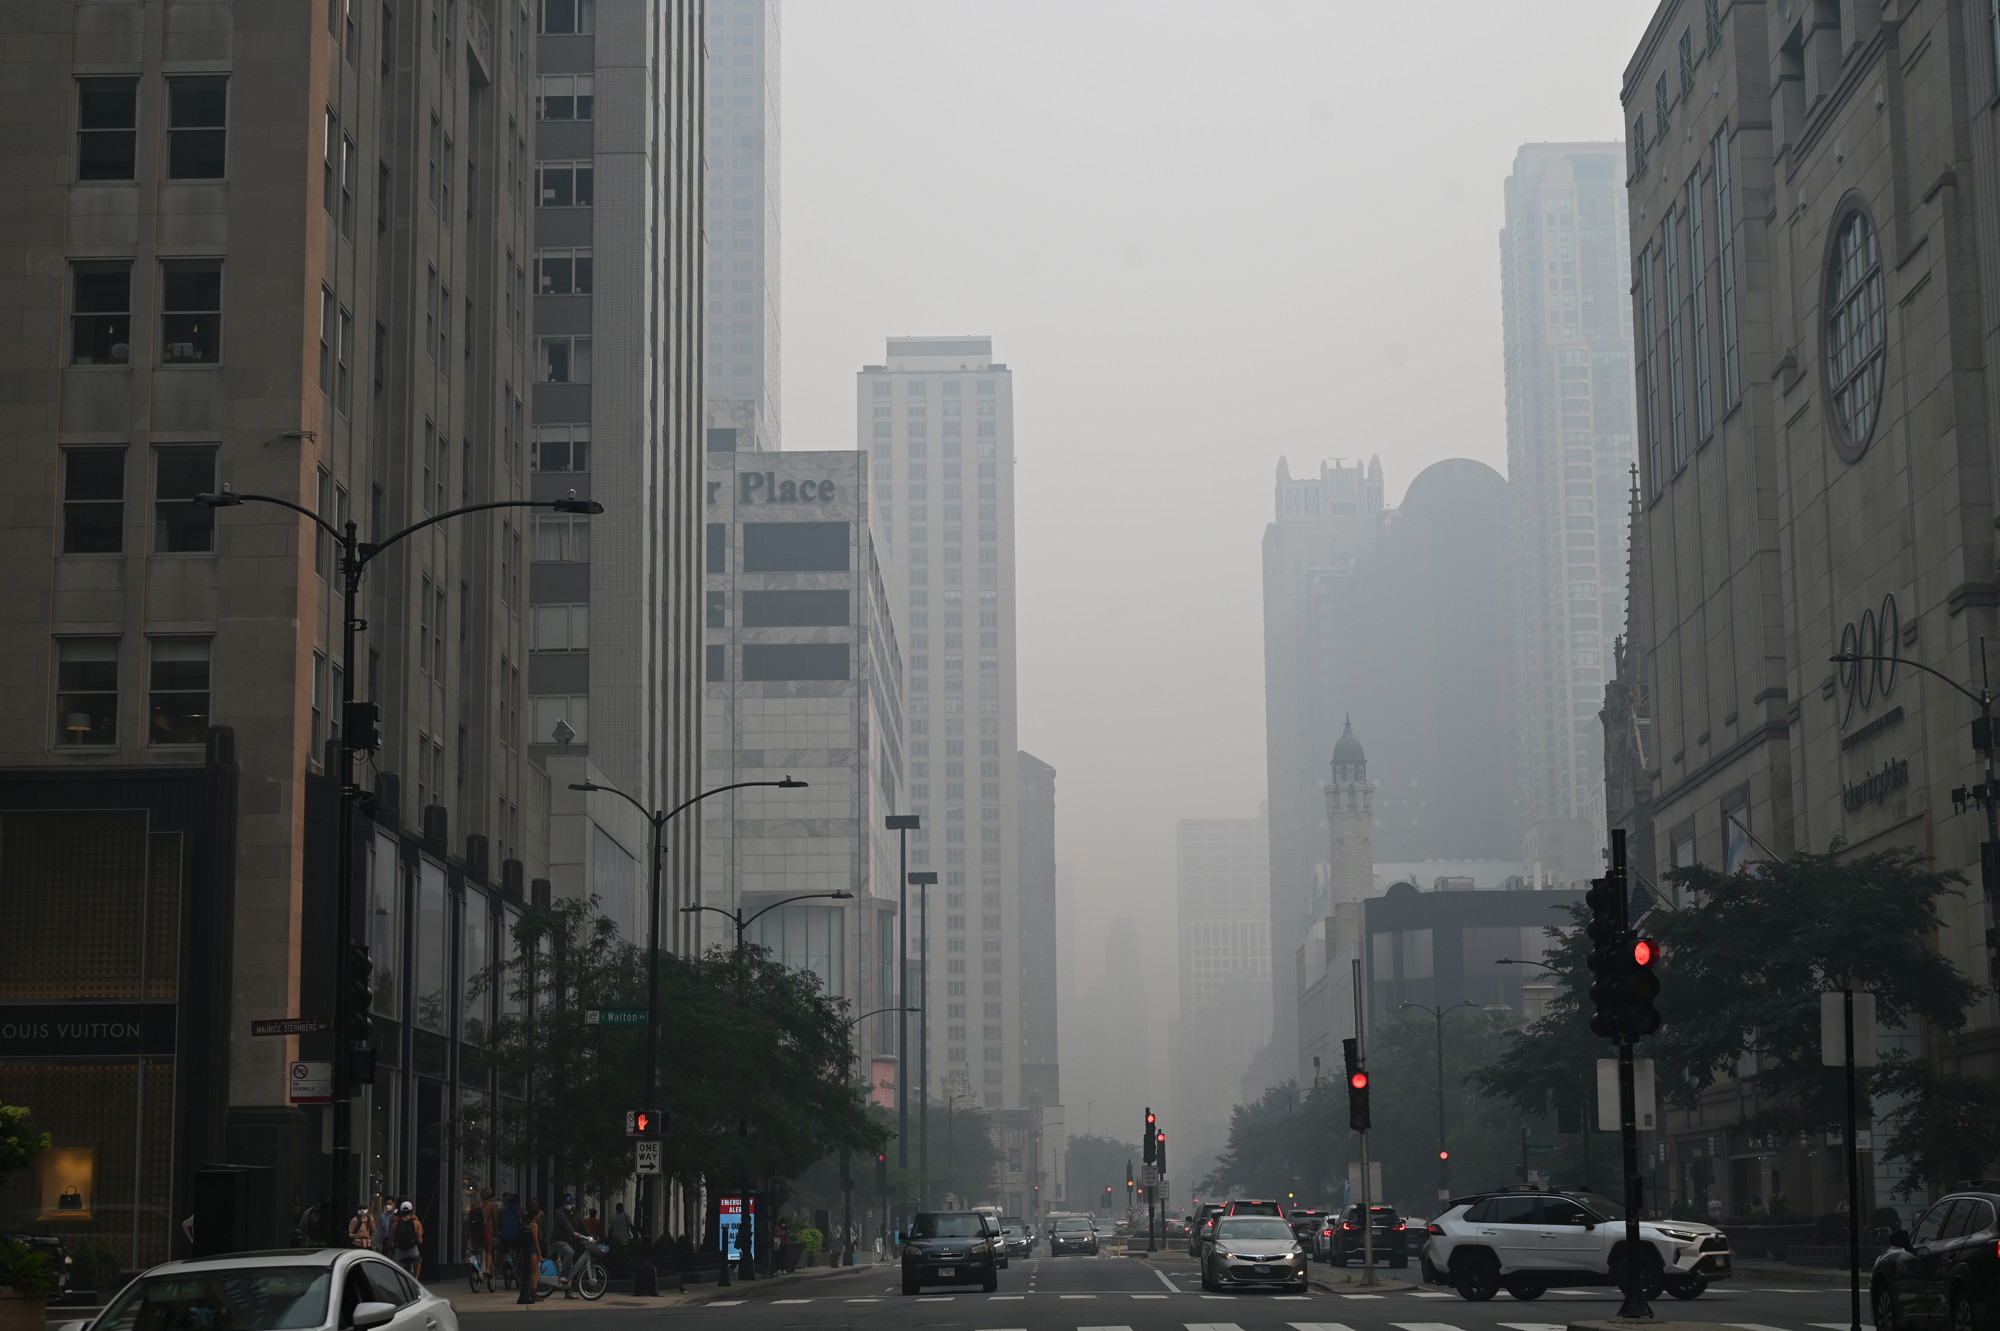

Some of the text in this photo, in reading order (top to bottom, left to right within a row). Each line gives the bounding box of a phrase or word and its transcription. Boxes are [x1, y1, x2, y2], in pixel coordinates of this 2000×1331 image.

[738, 471, 835, 504] Place
[1839, 592, 1898, 731] 900
[608, 1012, 637, 1022] Walton
[2, 1023, 140, 1039] OUIS VUITTON
[256, 1024, 282, 1034] MAURICE
[284, 1023, 317, 1033] STERNBERG
[639, 1144, 658, 1152] ONE
[638, 1153, 658, 1161] WAY
